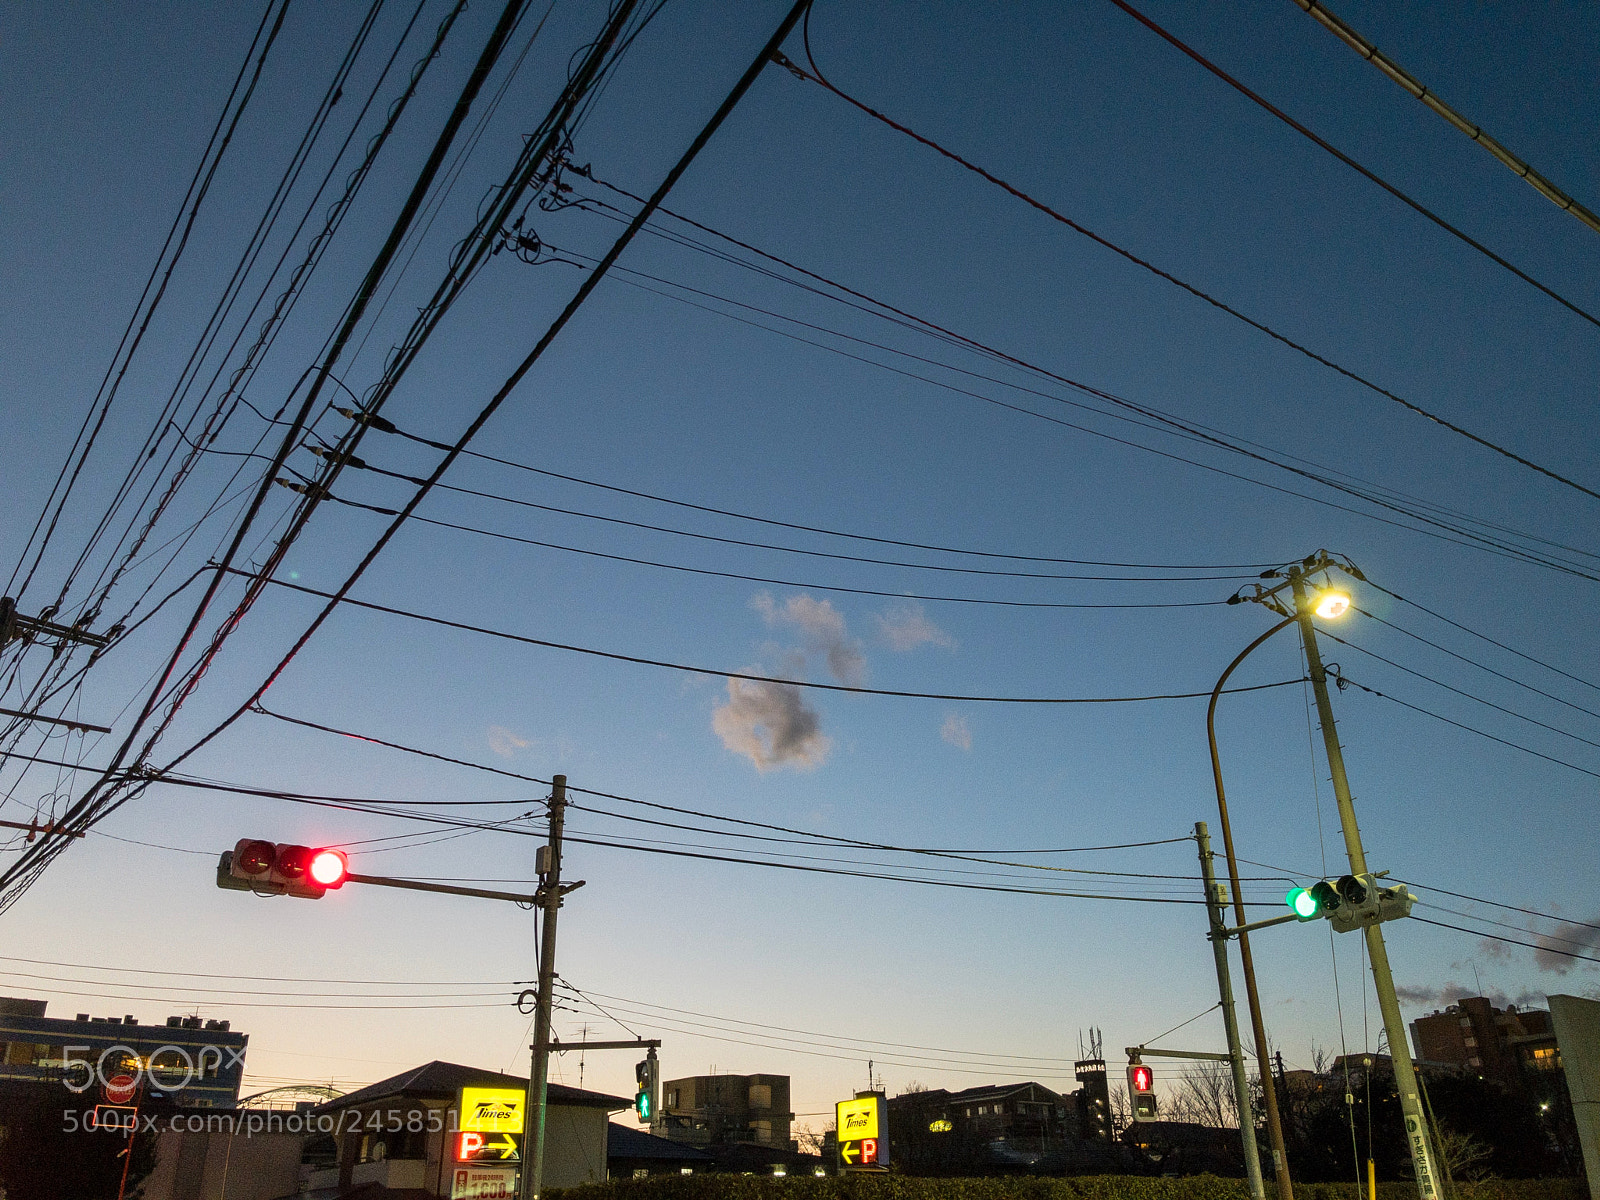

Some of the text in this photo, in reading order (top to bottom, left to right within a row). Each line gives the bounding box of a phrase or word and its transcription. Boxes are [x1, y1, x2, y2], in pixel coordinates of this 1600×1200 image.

[476, 1102, 517, 1119] Times
[846, 1111, 871, 1129] Times
[459, 1132, 483, 1159] P
[861, 1138, 877, 1164] P
